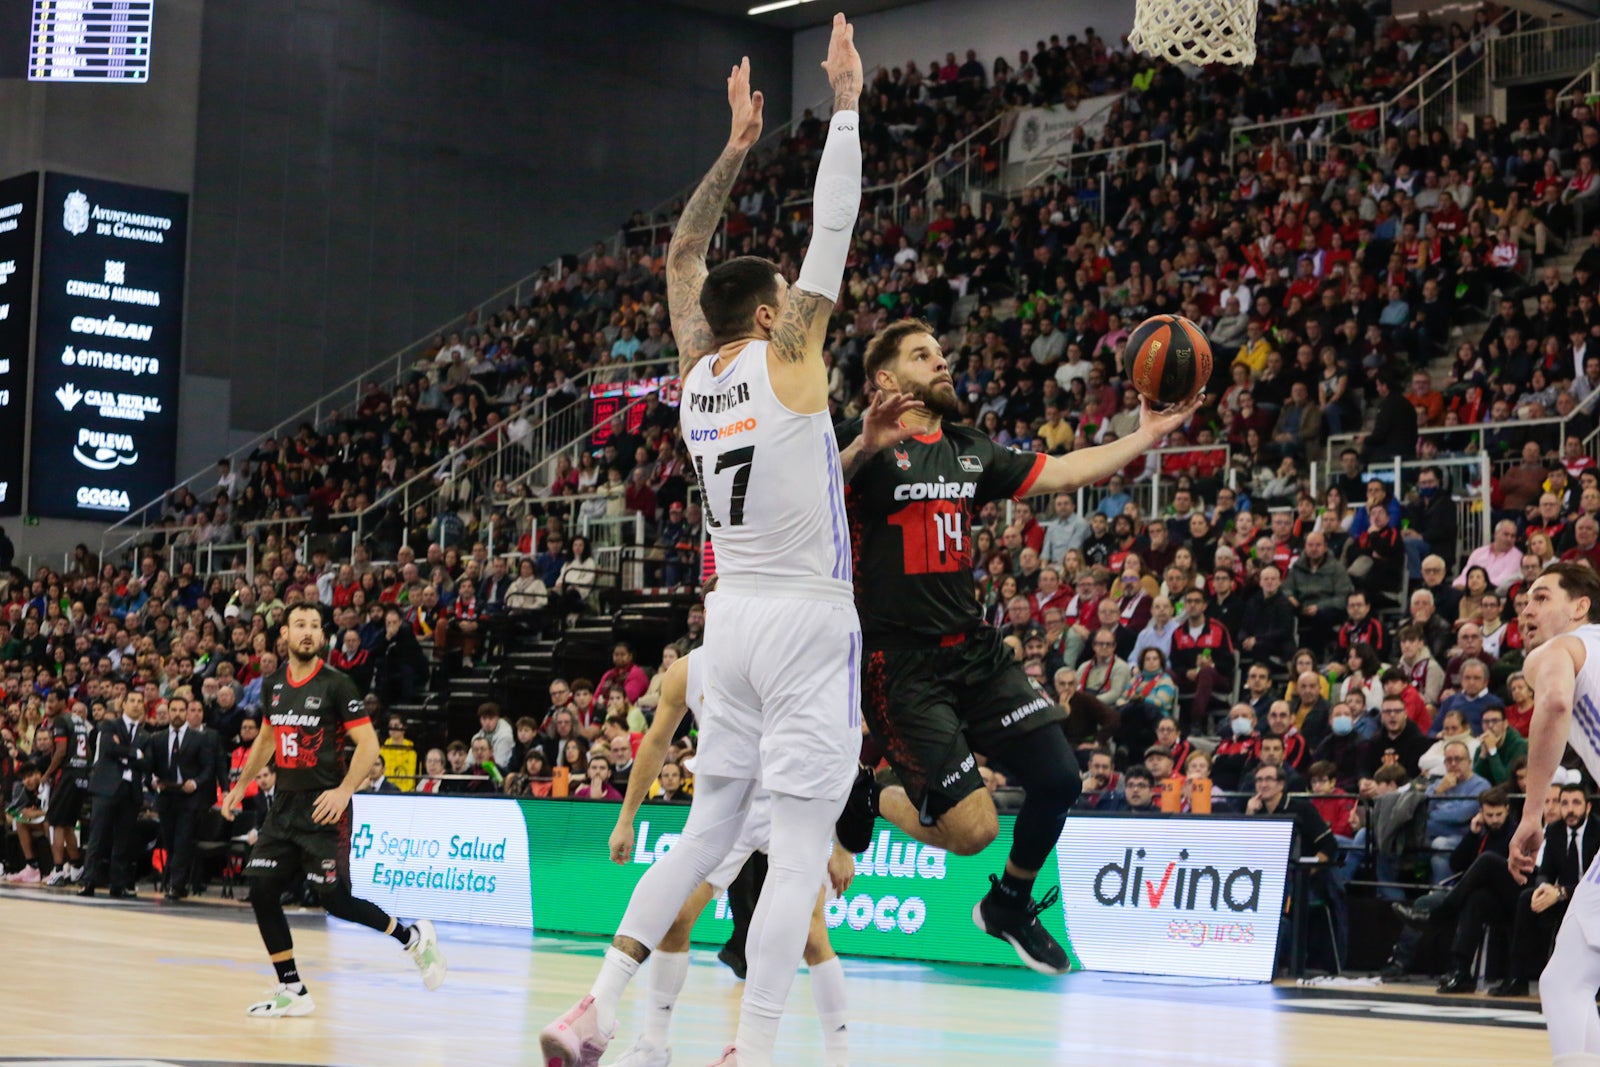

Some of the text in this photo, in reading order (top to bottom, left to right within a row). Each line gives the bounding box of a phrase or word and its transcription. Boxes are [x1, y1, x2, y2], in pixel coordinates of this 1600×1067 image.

[91, 204, 171, 230] AYUNTAMIENTO
[97, 223, 164, 243] DE GRANADA
[66, 279, 160, 307] CERVEZAS ALHAMBRA
[77, 348, 159, 376] emasagra
[84, 389, 117, 407] CAJA
[78, 427, 134, 451] PULEVA
[690, 418, 757, 441] AUTOHERO
[933, 512, 963, 552] 14
[280, 732, 298, 758] 15
[377, 831, 507, 862] Seguro Salud
[372, 862, 497, 894] Especialistas
[1093, 847, 1263, 913] divina
[1167, 920, 1254, 948] seguros
